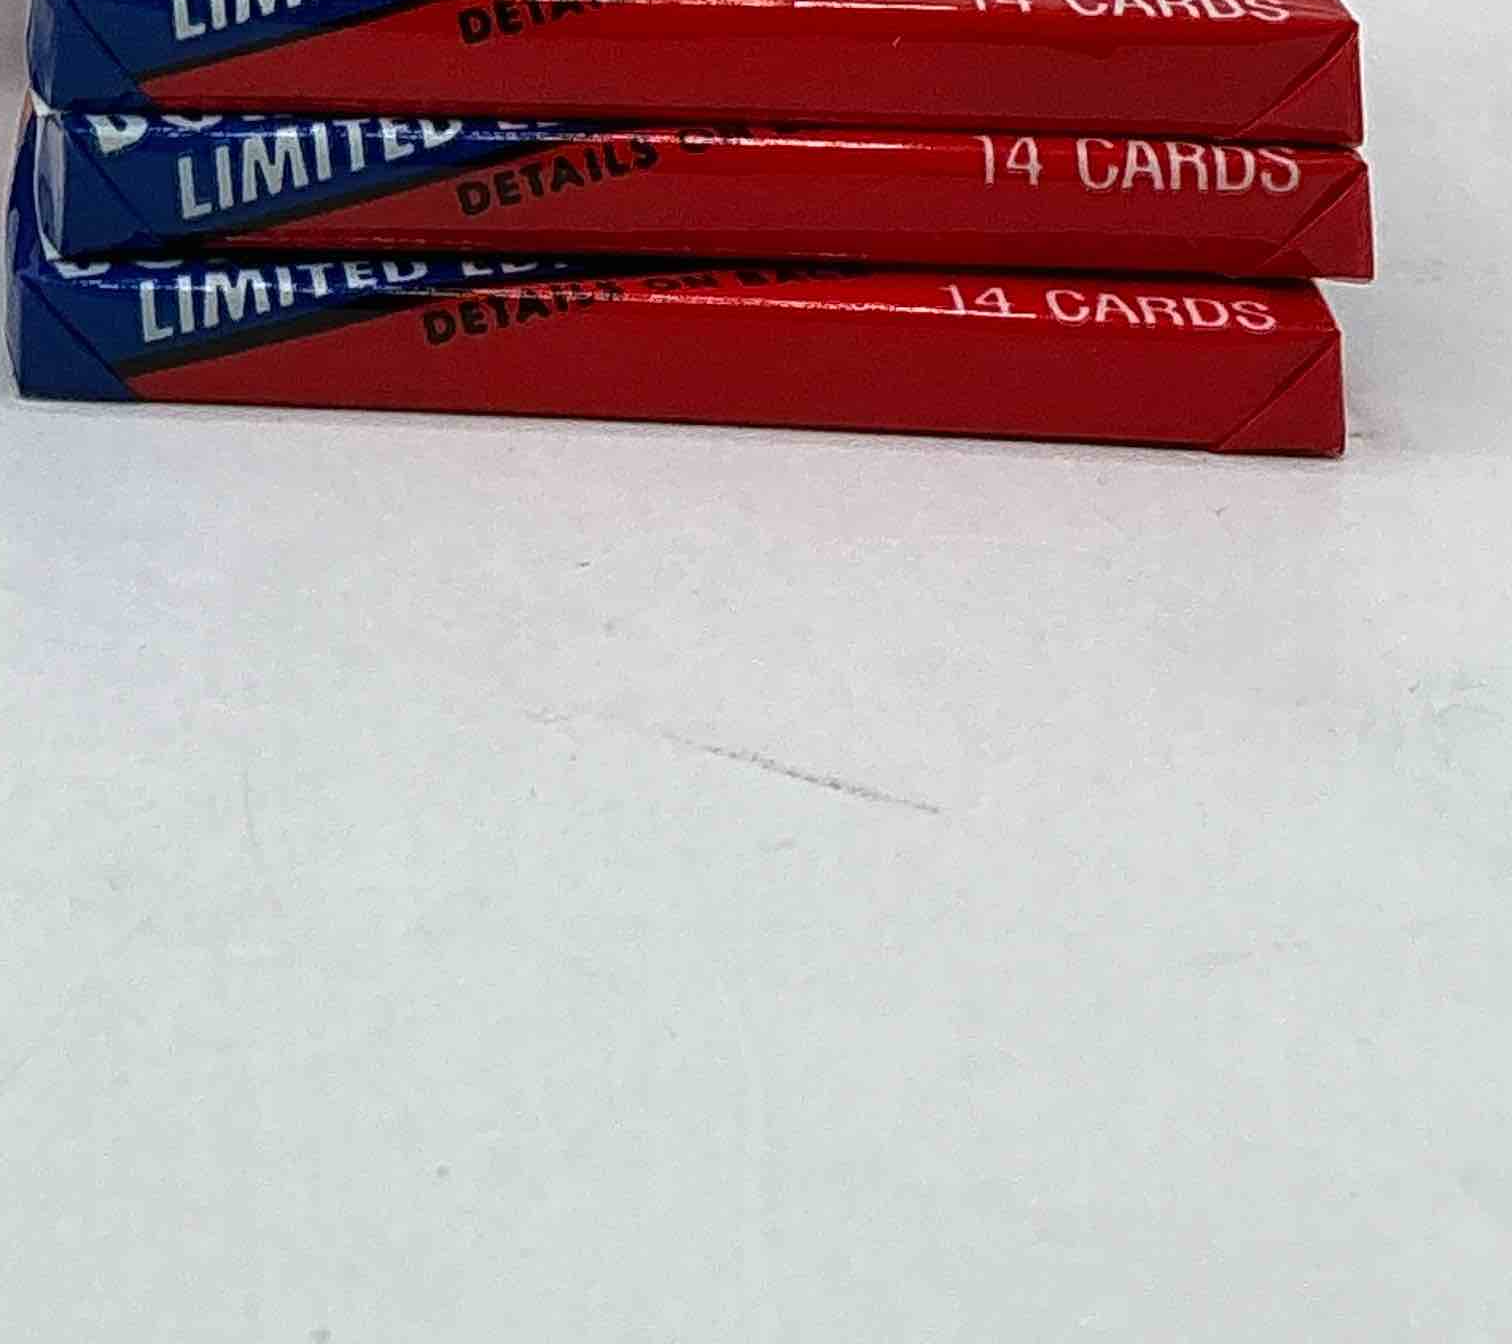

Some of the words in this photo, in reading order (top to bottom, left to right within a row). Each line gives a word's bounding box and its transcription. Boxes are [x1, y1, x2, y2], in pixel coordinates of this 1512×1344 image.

[177, 116, 463, 220] LIMITED
[456, 137, 659, 218] DETAILS
[978, 134, 1042, 187] 14
[1076, 137, 1300, 194] CARDS
[940, 283, 1017, 315] 14
[1045, 286, 1280, 332] CARDS
